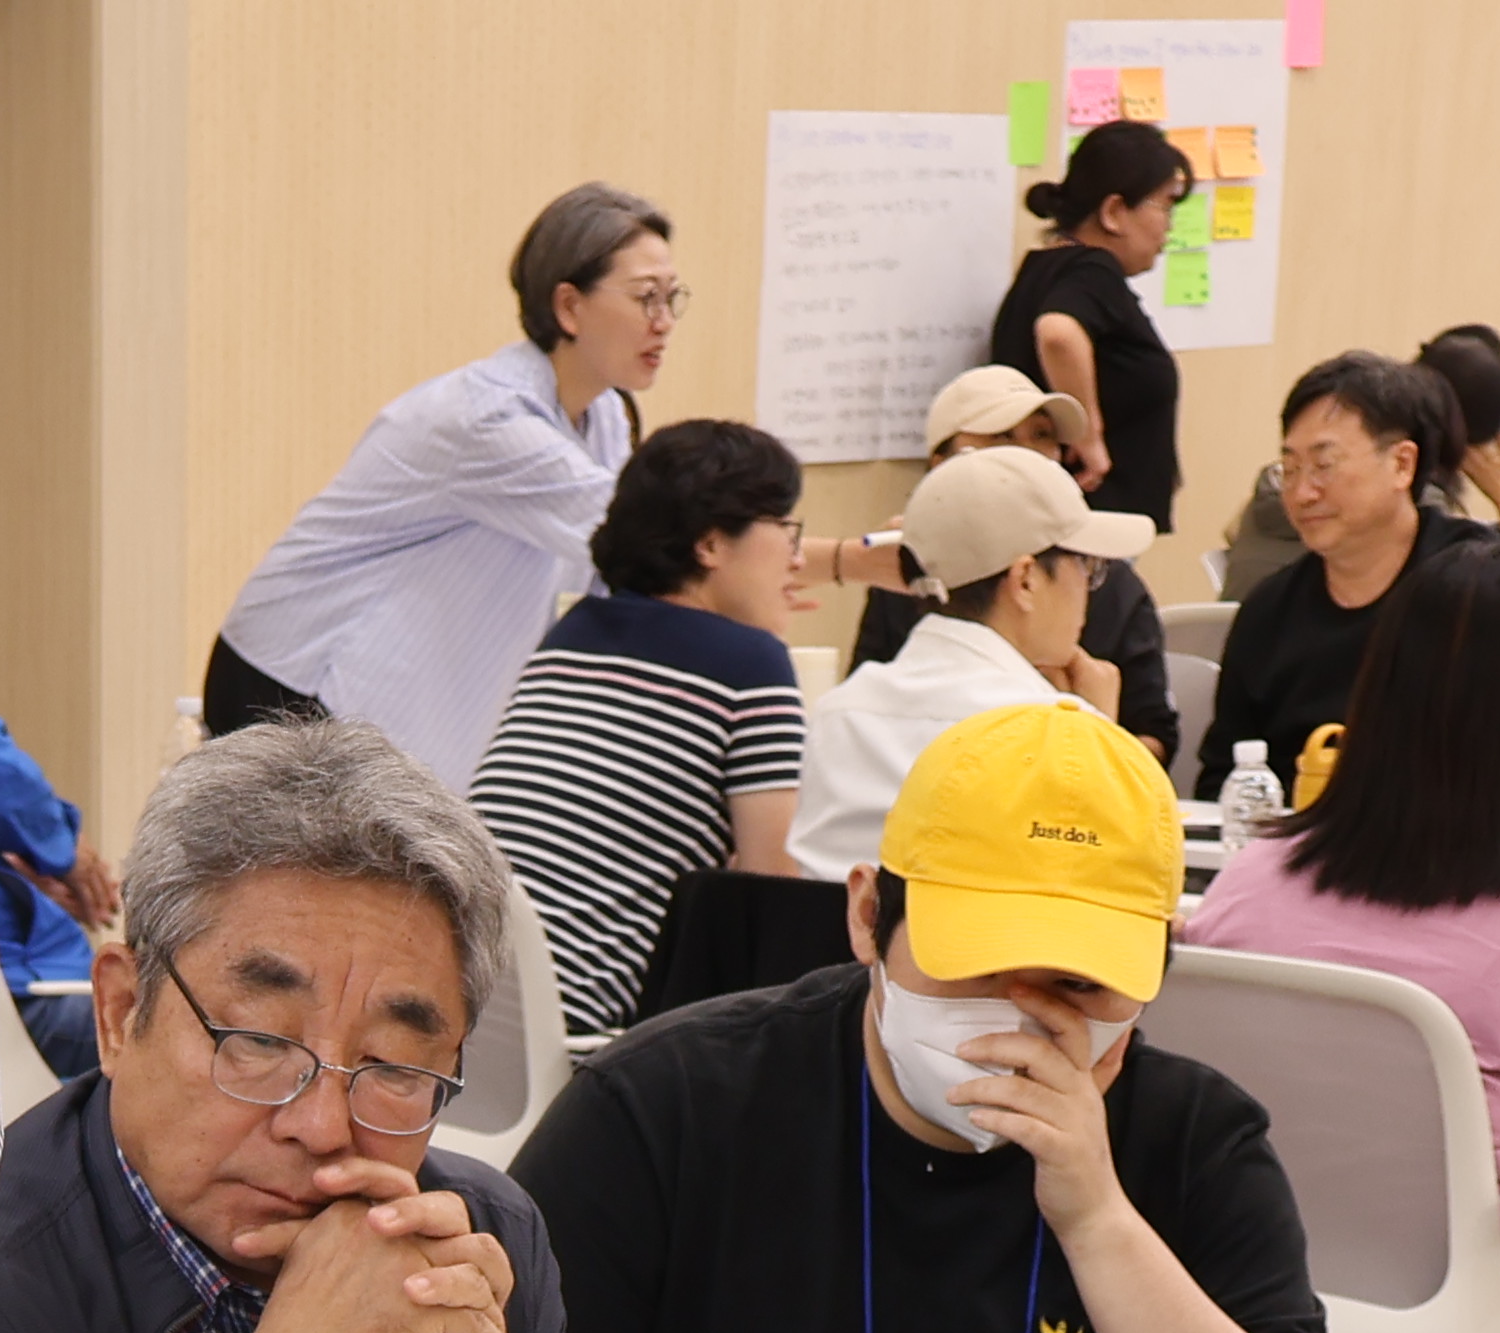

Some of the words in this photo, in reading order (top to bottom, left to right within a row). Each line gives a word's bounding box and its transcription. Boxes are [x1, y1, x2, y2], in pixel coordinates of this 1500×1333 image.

[1028, 821, 1062, 839] Just
[1064, 828, 1086, 844] do
[1088, 832, 1102, 846] it.
